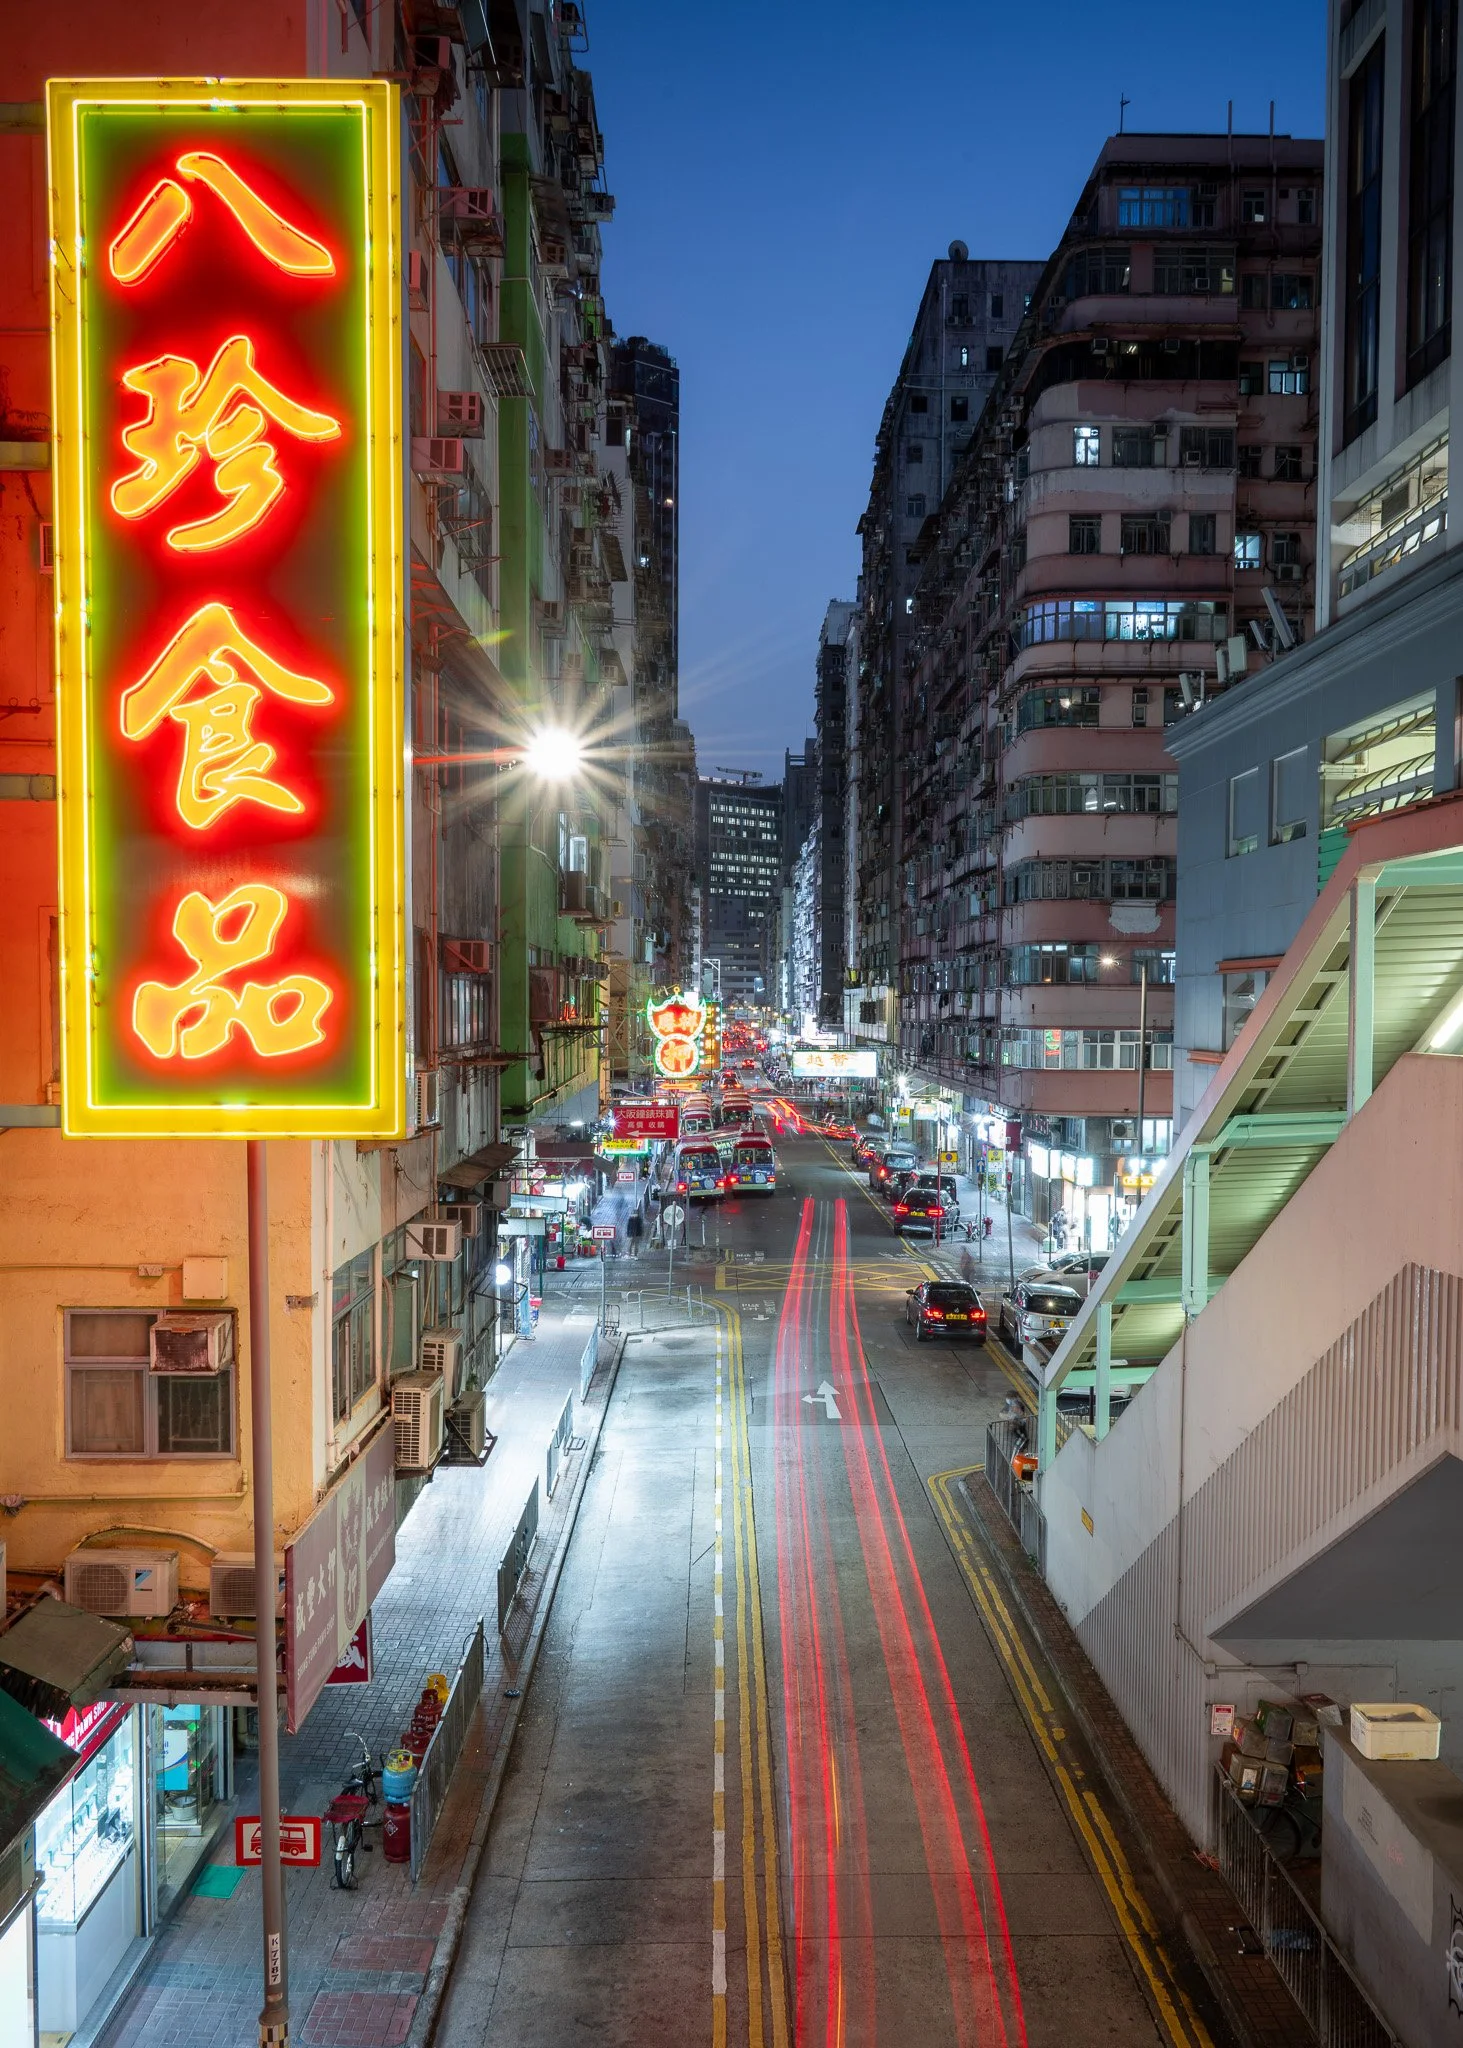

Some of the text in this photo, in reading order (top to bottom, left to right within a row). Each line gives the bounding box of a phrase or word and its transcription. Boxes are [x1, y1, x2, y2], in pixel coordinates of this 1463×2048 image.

[109, 151, 343, 1060] 八珍食品
[663, 1041, 691, 1072] 押
[77, 1710, 93, 1738] PAWN
